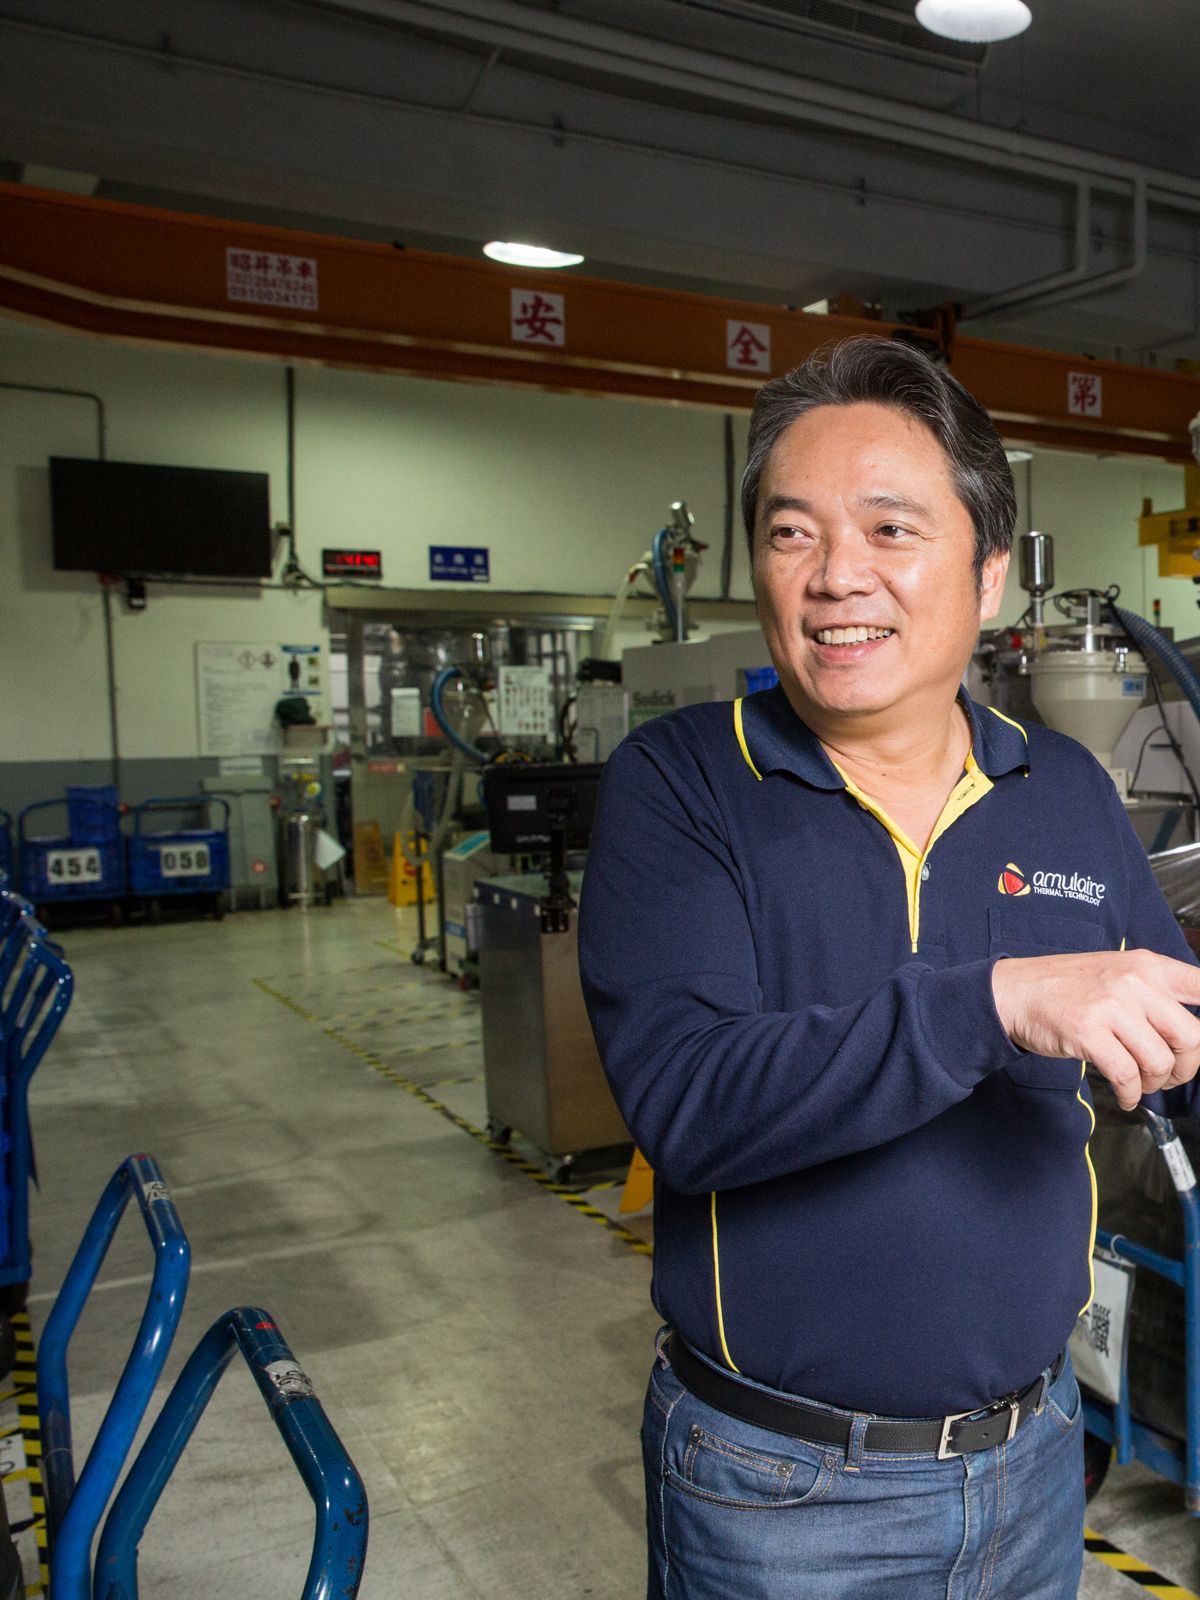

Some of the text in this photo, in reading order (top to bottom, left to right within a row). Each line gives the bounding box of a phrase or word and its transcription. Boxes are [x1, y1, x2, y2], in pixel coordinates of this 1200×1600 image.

[514, 294, 563, 342] 安
[730, 325, 768, 367] 全
[1032, 870, 1106, 899] amulaire
[1033, 886, 1101, 906] THERMAL TECHNOLOGY
